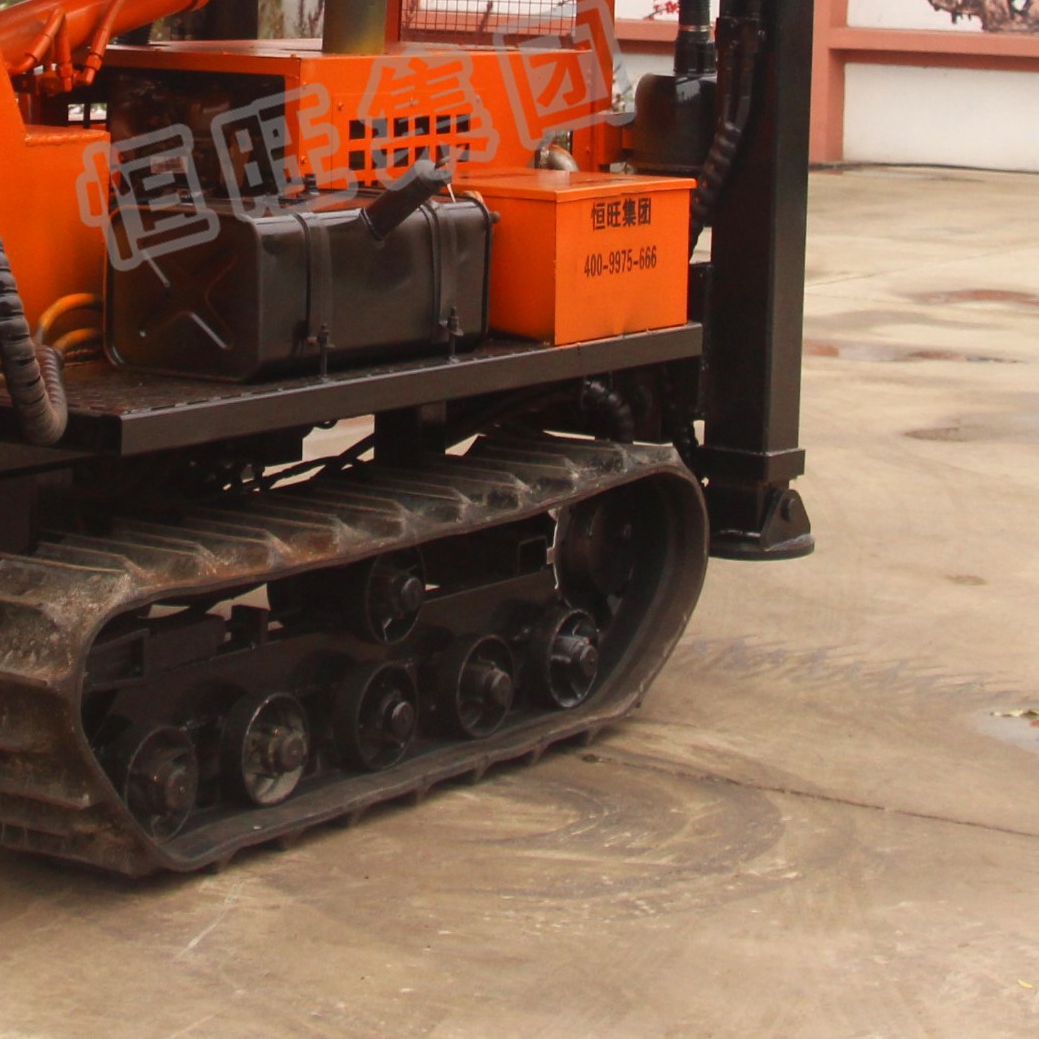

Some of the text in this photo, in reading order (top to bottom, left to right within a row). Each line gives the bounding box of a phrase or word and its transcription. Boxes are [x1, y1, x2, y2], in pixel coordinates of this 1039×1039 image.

[591, 197, 652, 231] 恒旺集团
[584, 245, 657, 278] 400-9975-666
